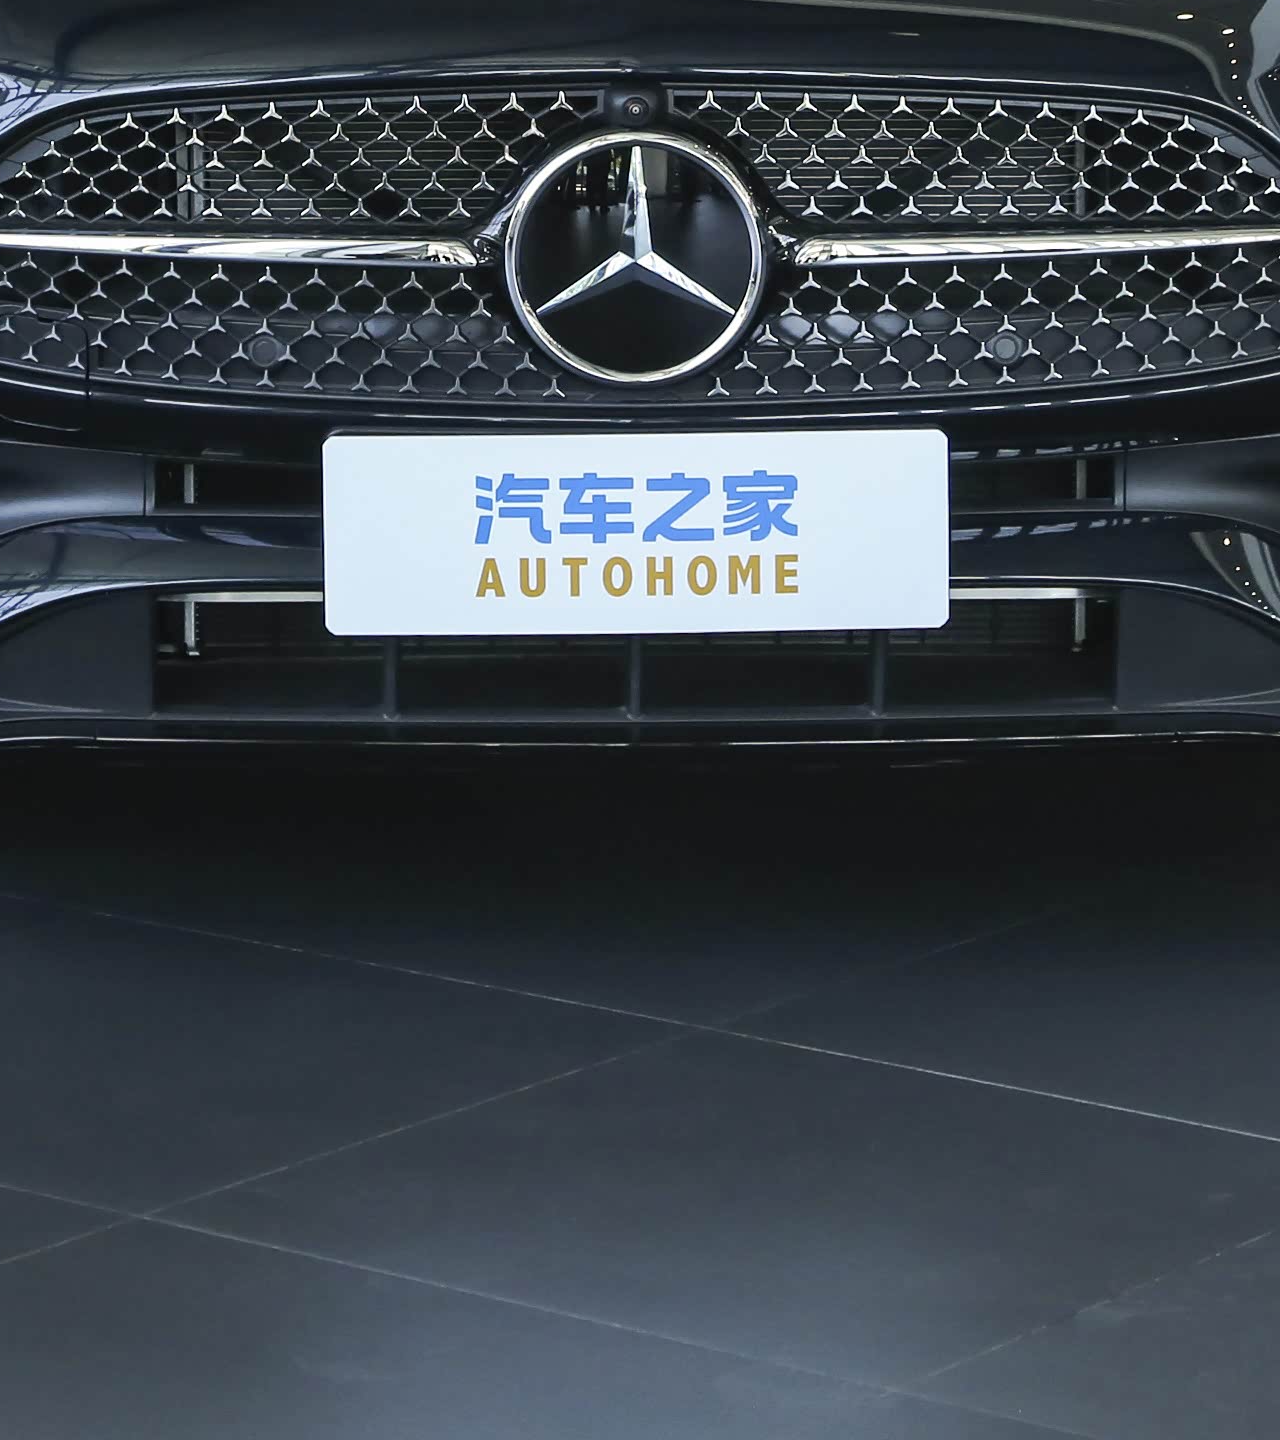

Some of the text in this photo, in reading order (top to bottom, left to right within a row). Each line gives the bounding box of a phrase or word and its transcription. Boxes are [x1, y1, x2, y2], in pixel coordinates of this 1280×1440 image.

[475, 470, 797, 544] 汽车之家
[476, 554, 799, 598] AUTOHOME
